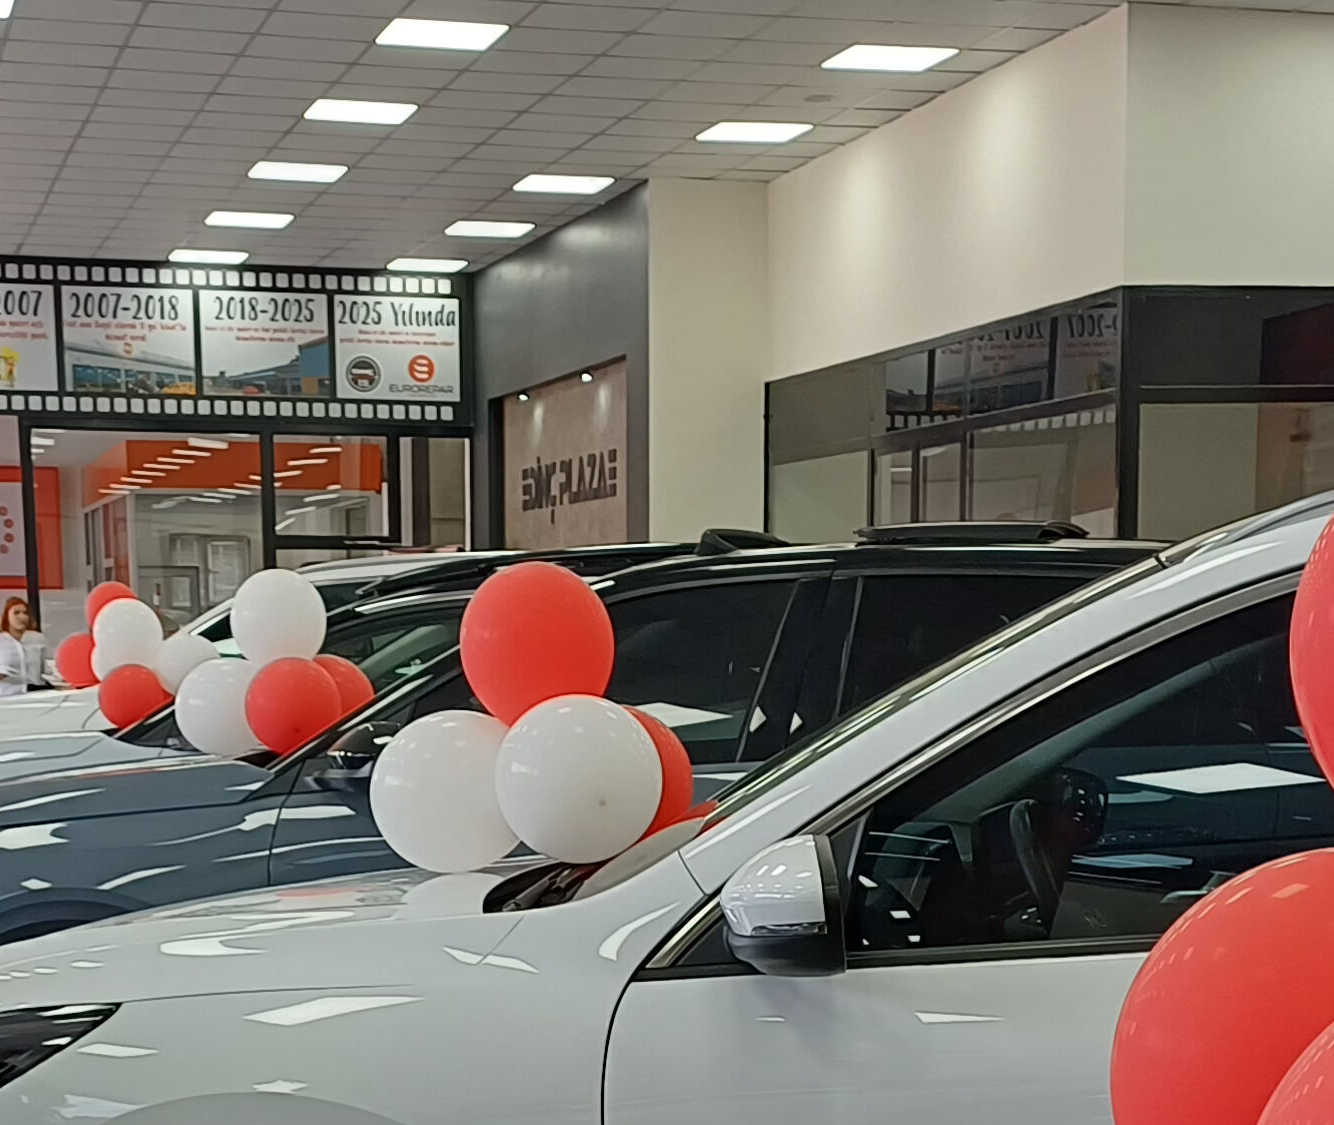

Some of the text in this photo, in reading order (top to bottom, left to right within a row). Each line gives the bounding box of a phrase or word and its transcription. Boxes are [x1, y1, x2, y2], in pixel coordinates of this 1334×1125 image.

[70, 292, 179, 321] 2007-2018
[214, 295, 315, 324] 2018-2025
[337, 300, 383, 325] 2025
